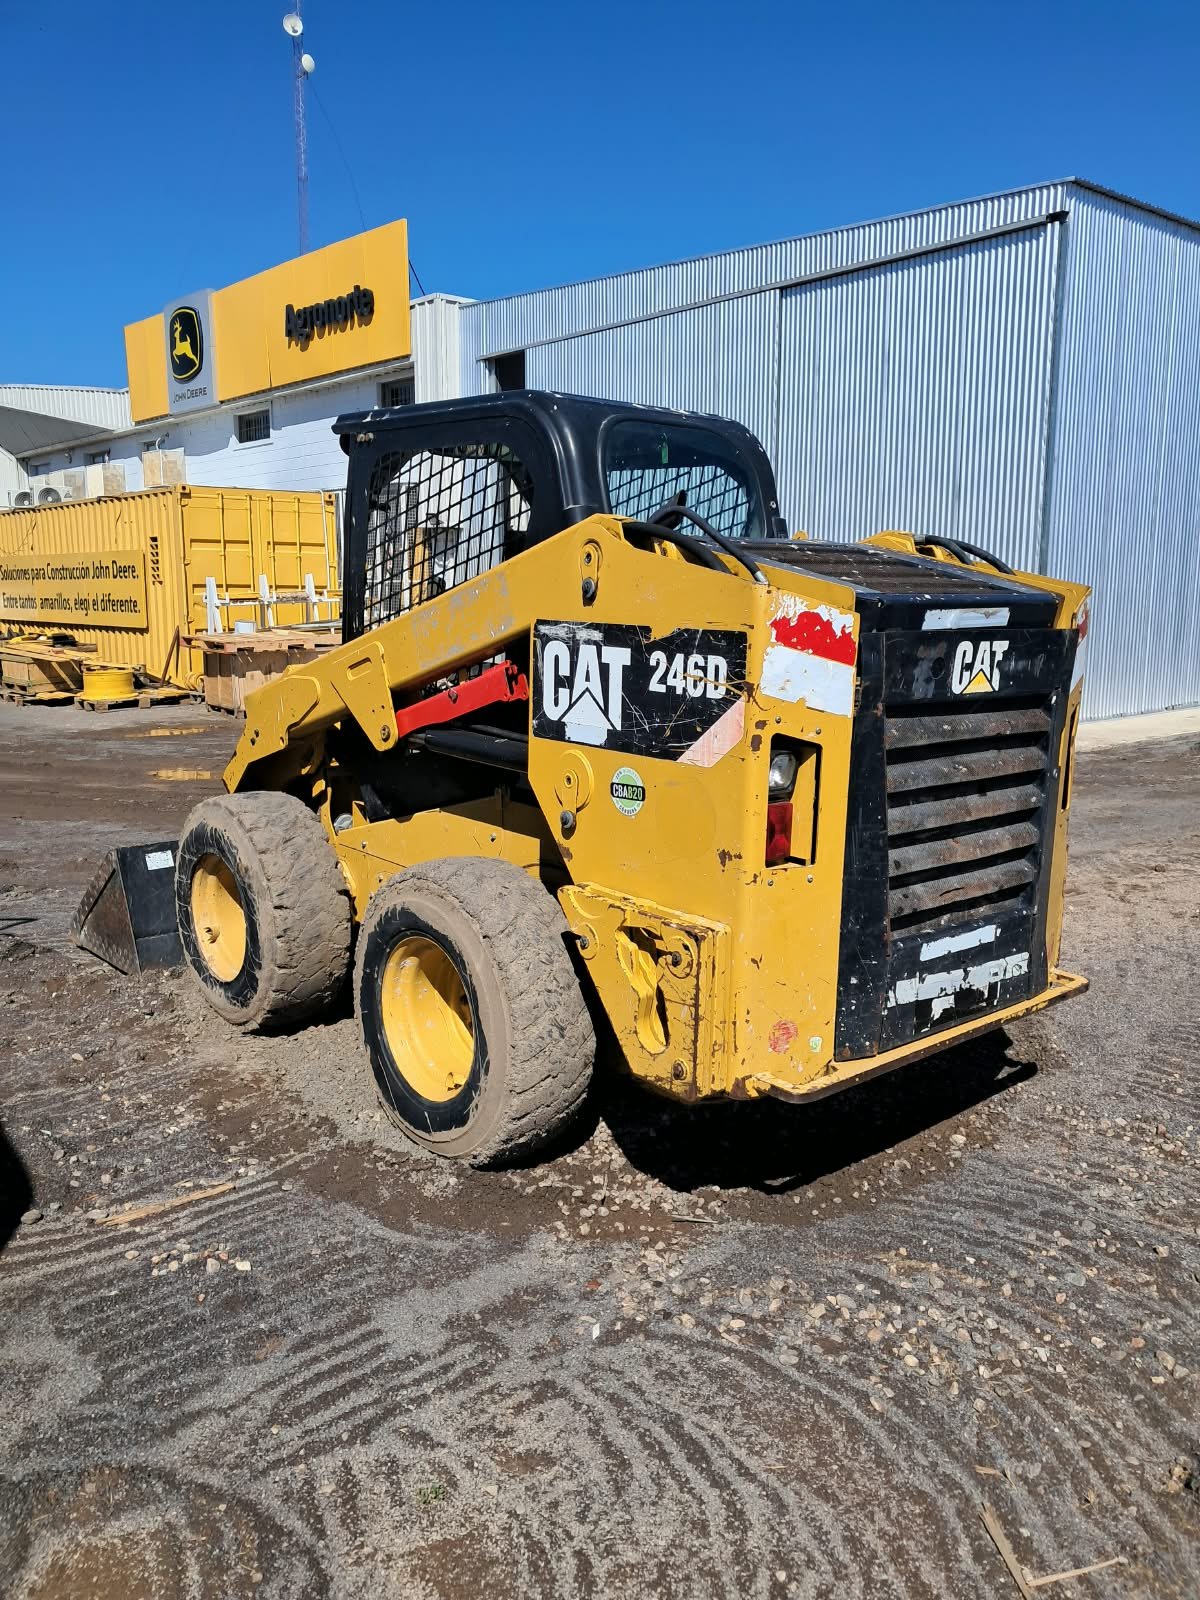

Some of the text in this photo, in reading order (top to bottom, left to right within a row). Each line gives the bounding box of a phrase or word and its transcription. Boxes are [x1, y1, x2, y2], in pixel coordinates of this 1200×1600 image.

[285, 285, 374, 343] Agronorte
[173, 387, 207, 403] JOHN DEERE
[0, 560, 139, 585] Soluciones para Construcción John Deere.
[3, 592, 18, 608] Entre
[19, 594, 37, 609] tantos
[40, 592, 73, 613] amarillos,
[92, 593, 99, 611] el
[101, 593, 141, 613] diferente.
[543, 641, 728, 731] CAT 246D
[952, 641, 1009, 694] CAT
